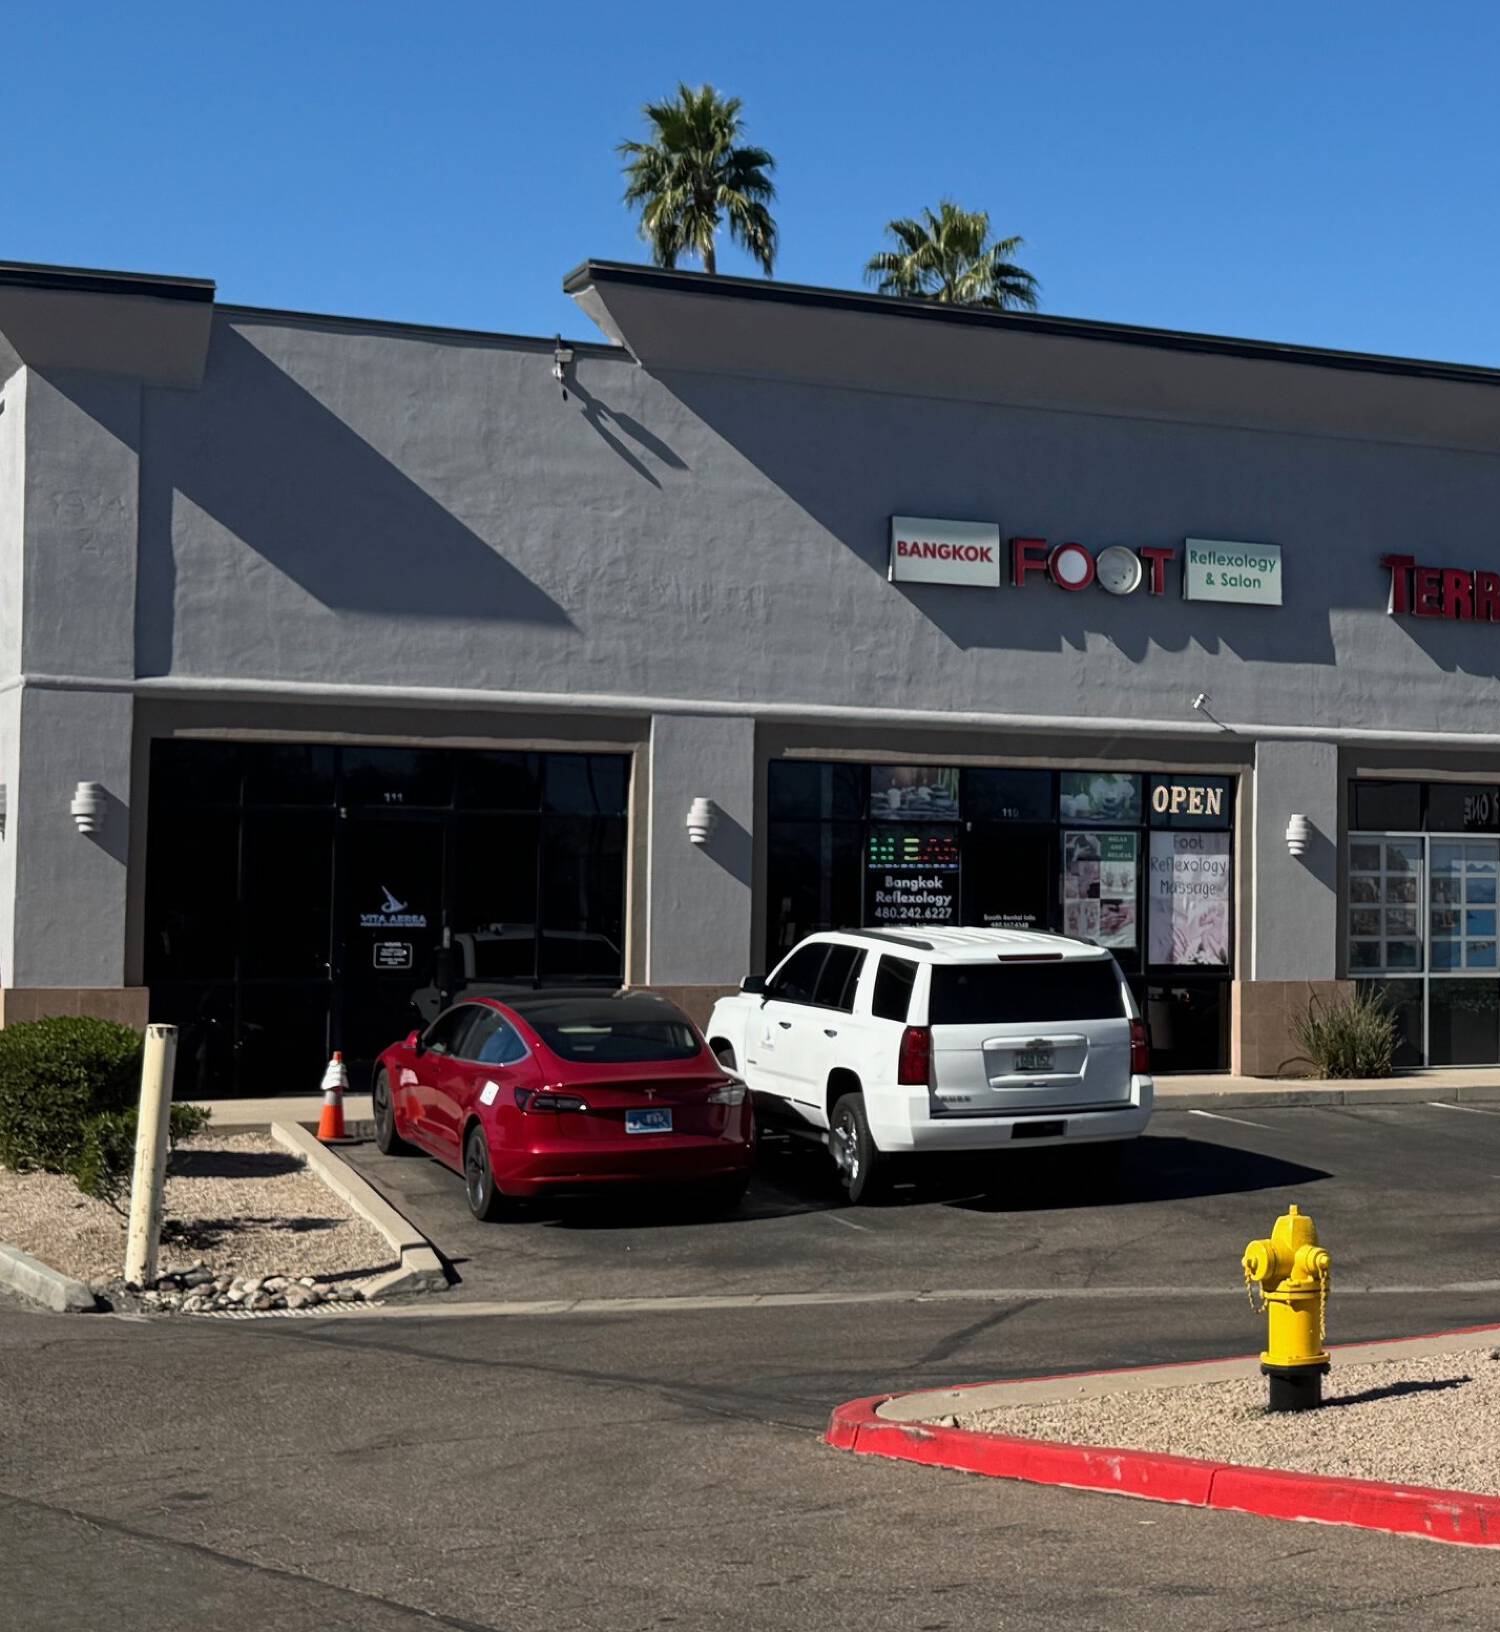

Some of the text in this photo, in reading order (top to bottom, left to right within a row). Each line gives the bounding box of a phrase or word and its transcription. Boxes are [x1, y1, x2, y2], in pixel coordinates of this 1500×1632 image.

[896, 540, 994, 563] BANGKOK
[1009, 537, 1176, 595] FOOT
[1189, 549, 1277, 573] Reflexology
[1205, 573, 1262, 589] & Salon
[1152, 784, 1224, 816] OPEN
[1173, 835, 1206, 849] Foot
[1150, 856, 1228, 874] Reflexology
[884, 875, 943, 891] Bangkok
[1160, 880, 1217, 899] Massage
[875, 891, 952, 906] Reflexology
[875, 907, 953, 919] 480.242.6227
